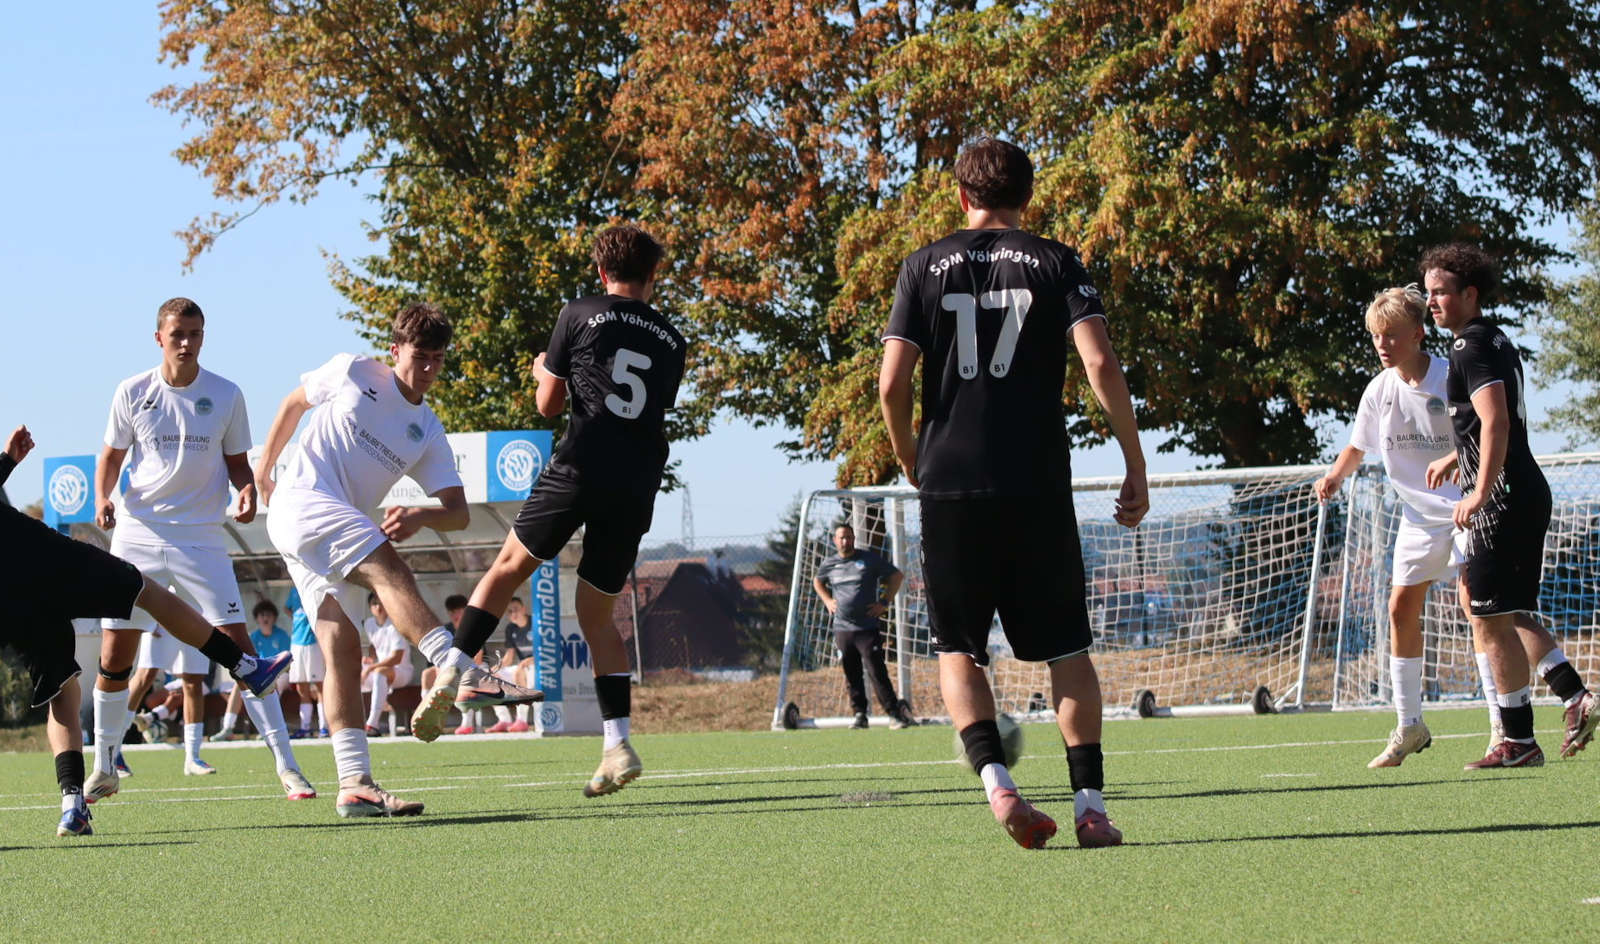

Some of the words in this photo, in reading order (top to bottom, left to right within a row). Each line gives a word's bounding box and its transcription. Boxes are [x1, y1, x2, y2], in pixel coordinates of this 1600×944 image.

[929, 251, 964, 277] SGM
[966, 247, 1040, 269] Vöhringen
[587, 311, 617, 328] SGM
[620, 311, 678, 350] Vöhringen
[941, 288, 1033, 380] 17
[604, 347, 652, 419] 5
[162, 434, 210, 444] BAUBREUUNG
